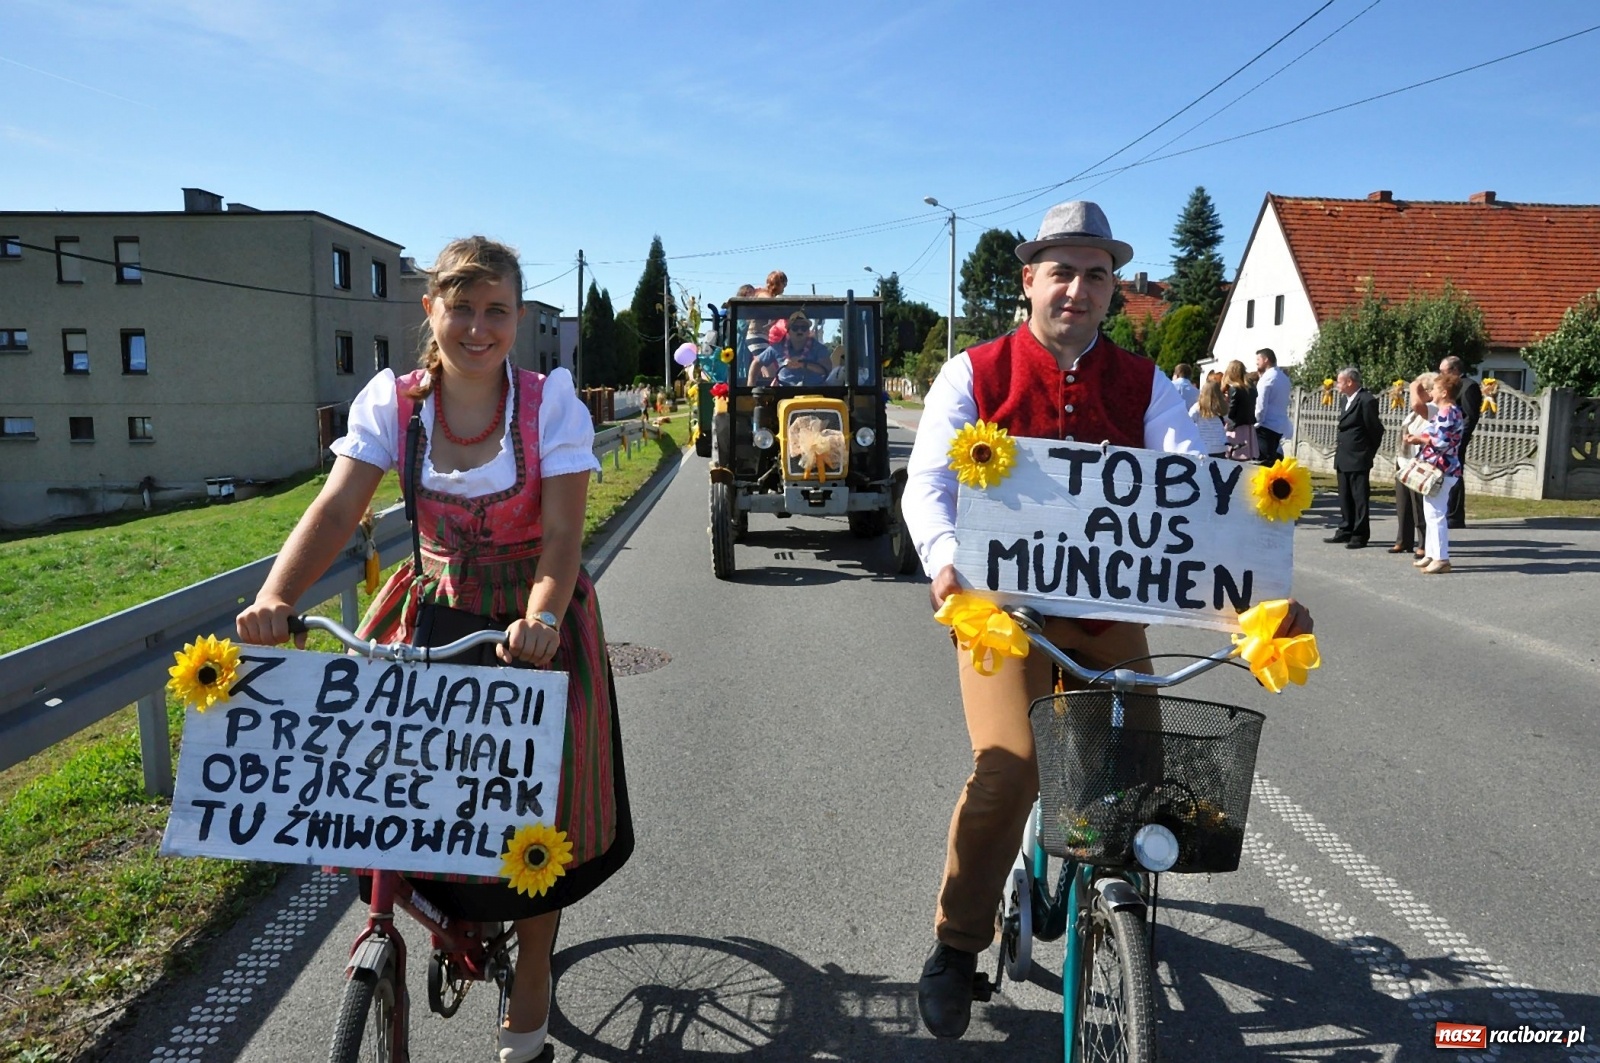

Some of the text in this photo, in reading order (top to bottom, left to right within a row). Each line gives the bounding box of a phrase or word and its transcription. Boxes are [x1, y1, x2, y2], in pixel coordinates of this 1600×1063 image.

[1048, 447, 1244, 515] TOBY
[1084, 506, 1194, 554] AUS
[986, 530, 1253, 614] MÜNCHEN
[229, 655, 544, 726] Z BAWARII
[226, 707, 535, 779] PRZYJECHALI
[190, 800, 267, 846] TU
[456, 775, 543, 820] JAK
